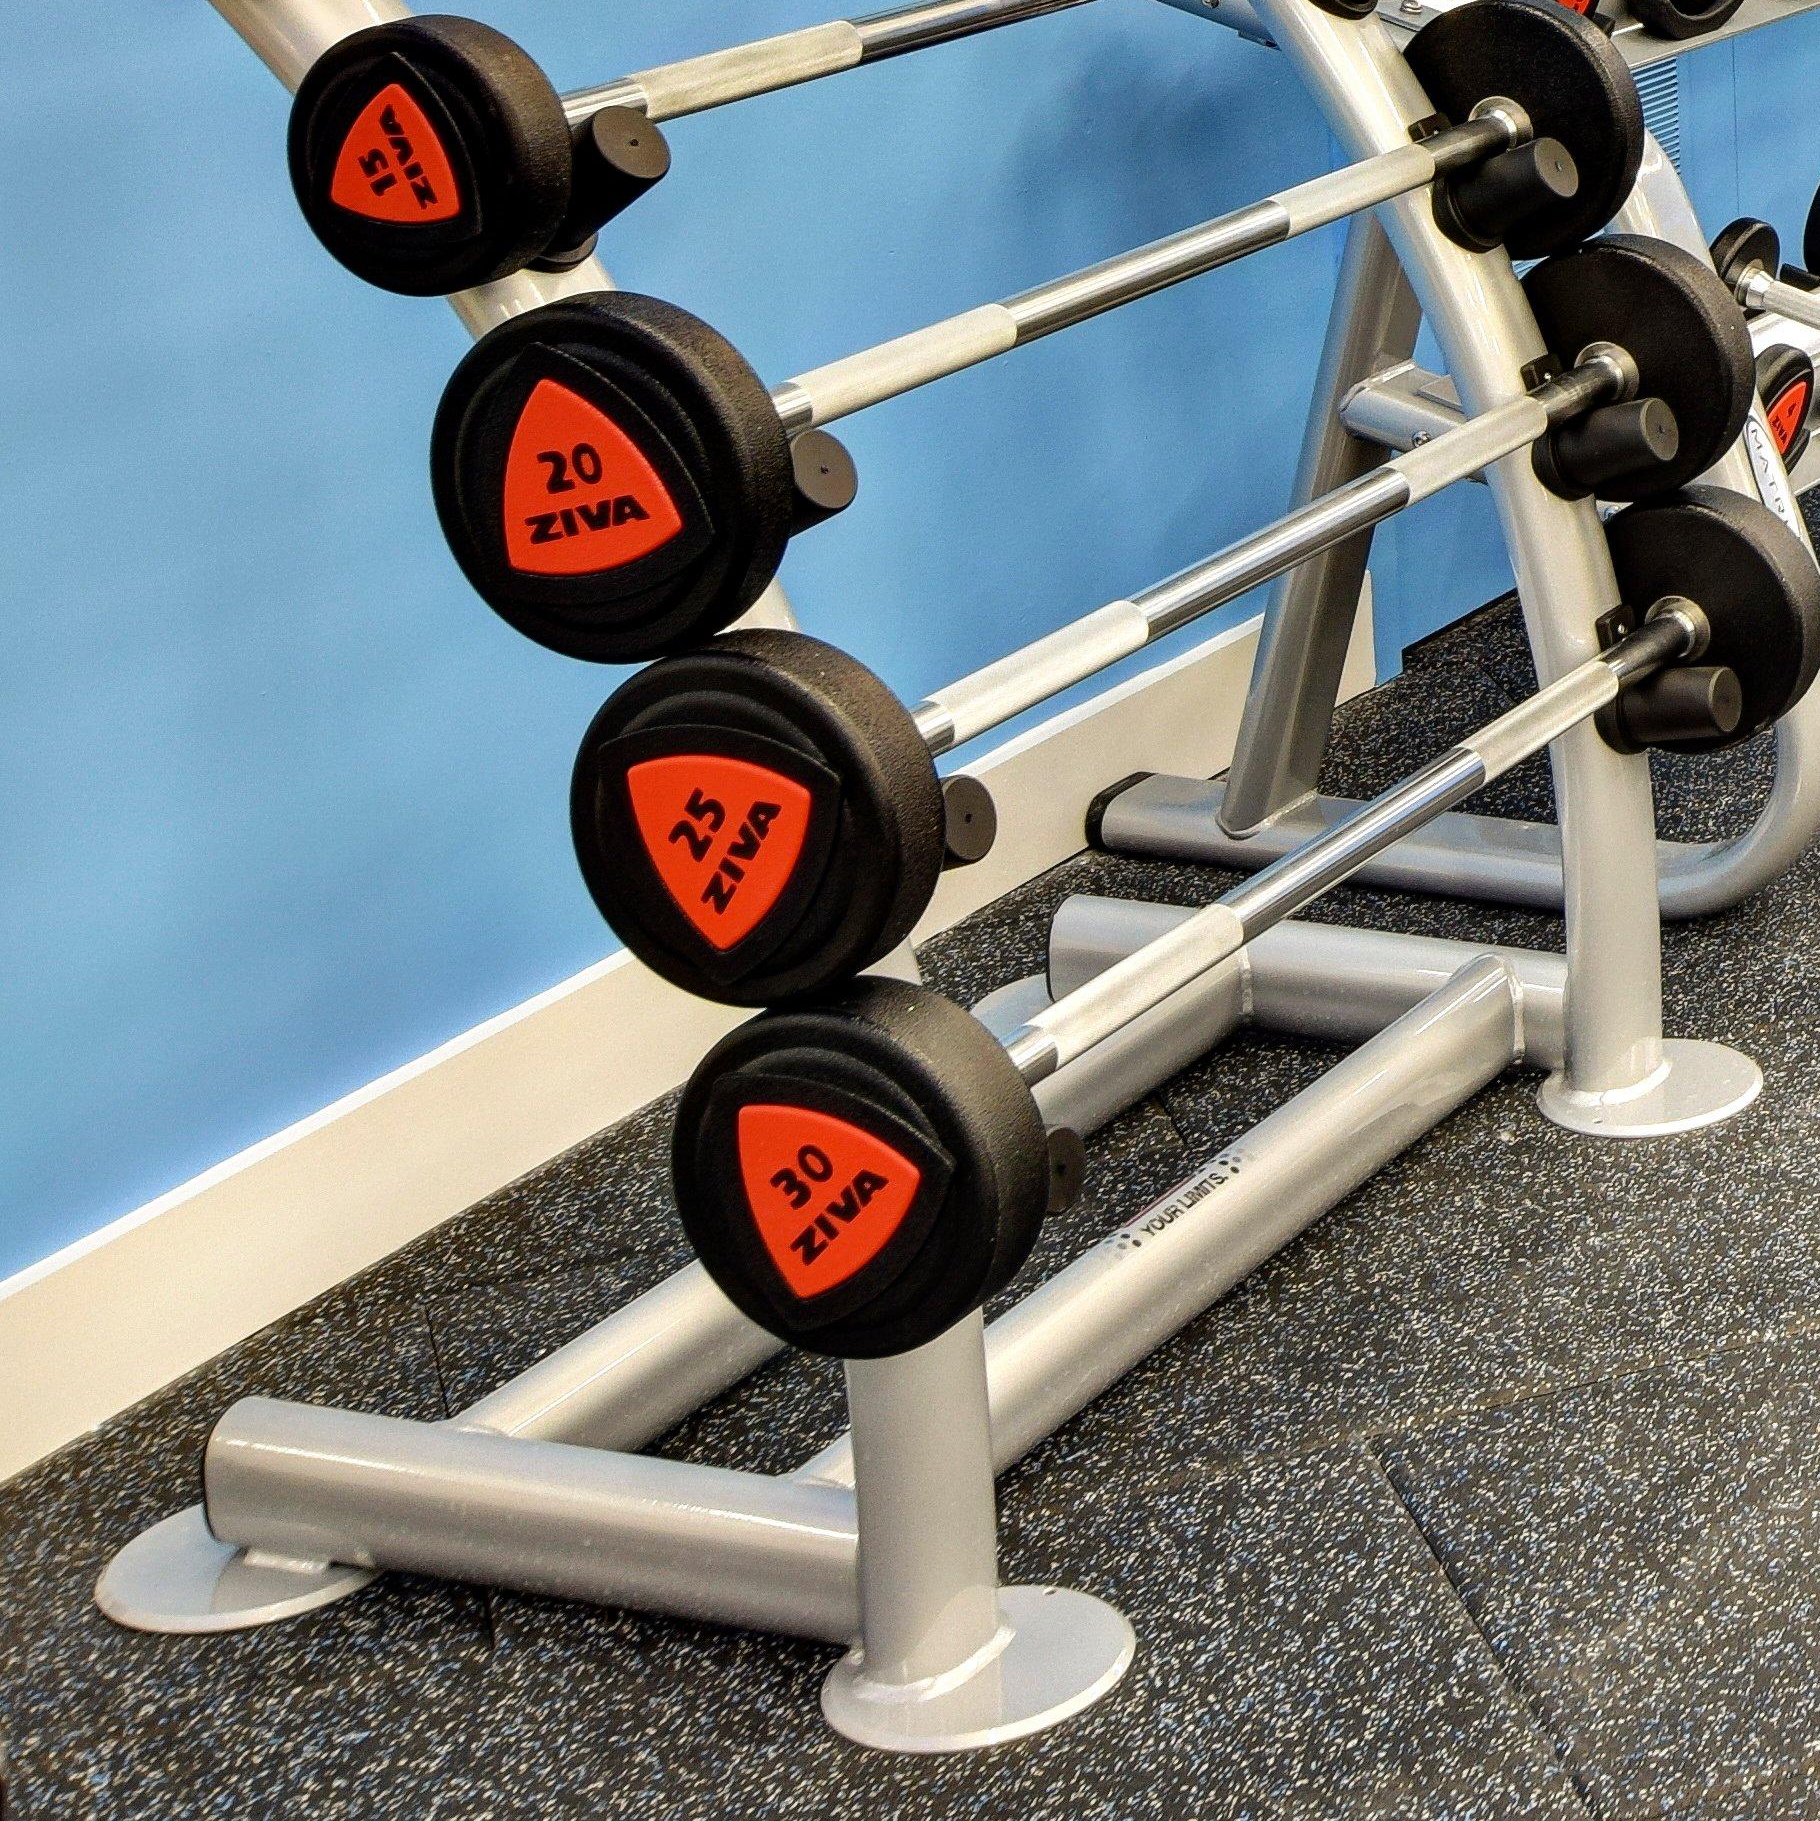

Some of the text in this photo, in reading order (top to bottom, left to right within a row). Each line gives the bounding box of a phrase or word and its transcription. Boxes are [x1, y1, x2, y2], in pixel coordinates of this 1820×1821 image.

[357, 147, 400, 197] 15
[379, 103, 438, 211] ZIVA
[535, 442, 603, 497] 20
[524, 494, 651, 546] ZIVA
[668, 787, 727, 863] 25
[701, 799, 783, 915] ZIVA
[770, 1145, 835, 1211] 30
[788, 1169, 890, 1267] ZIVA
[1140, 1204, 1186, 1237] YOUR
